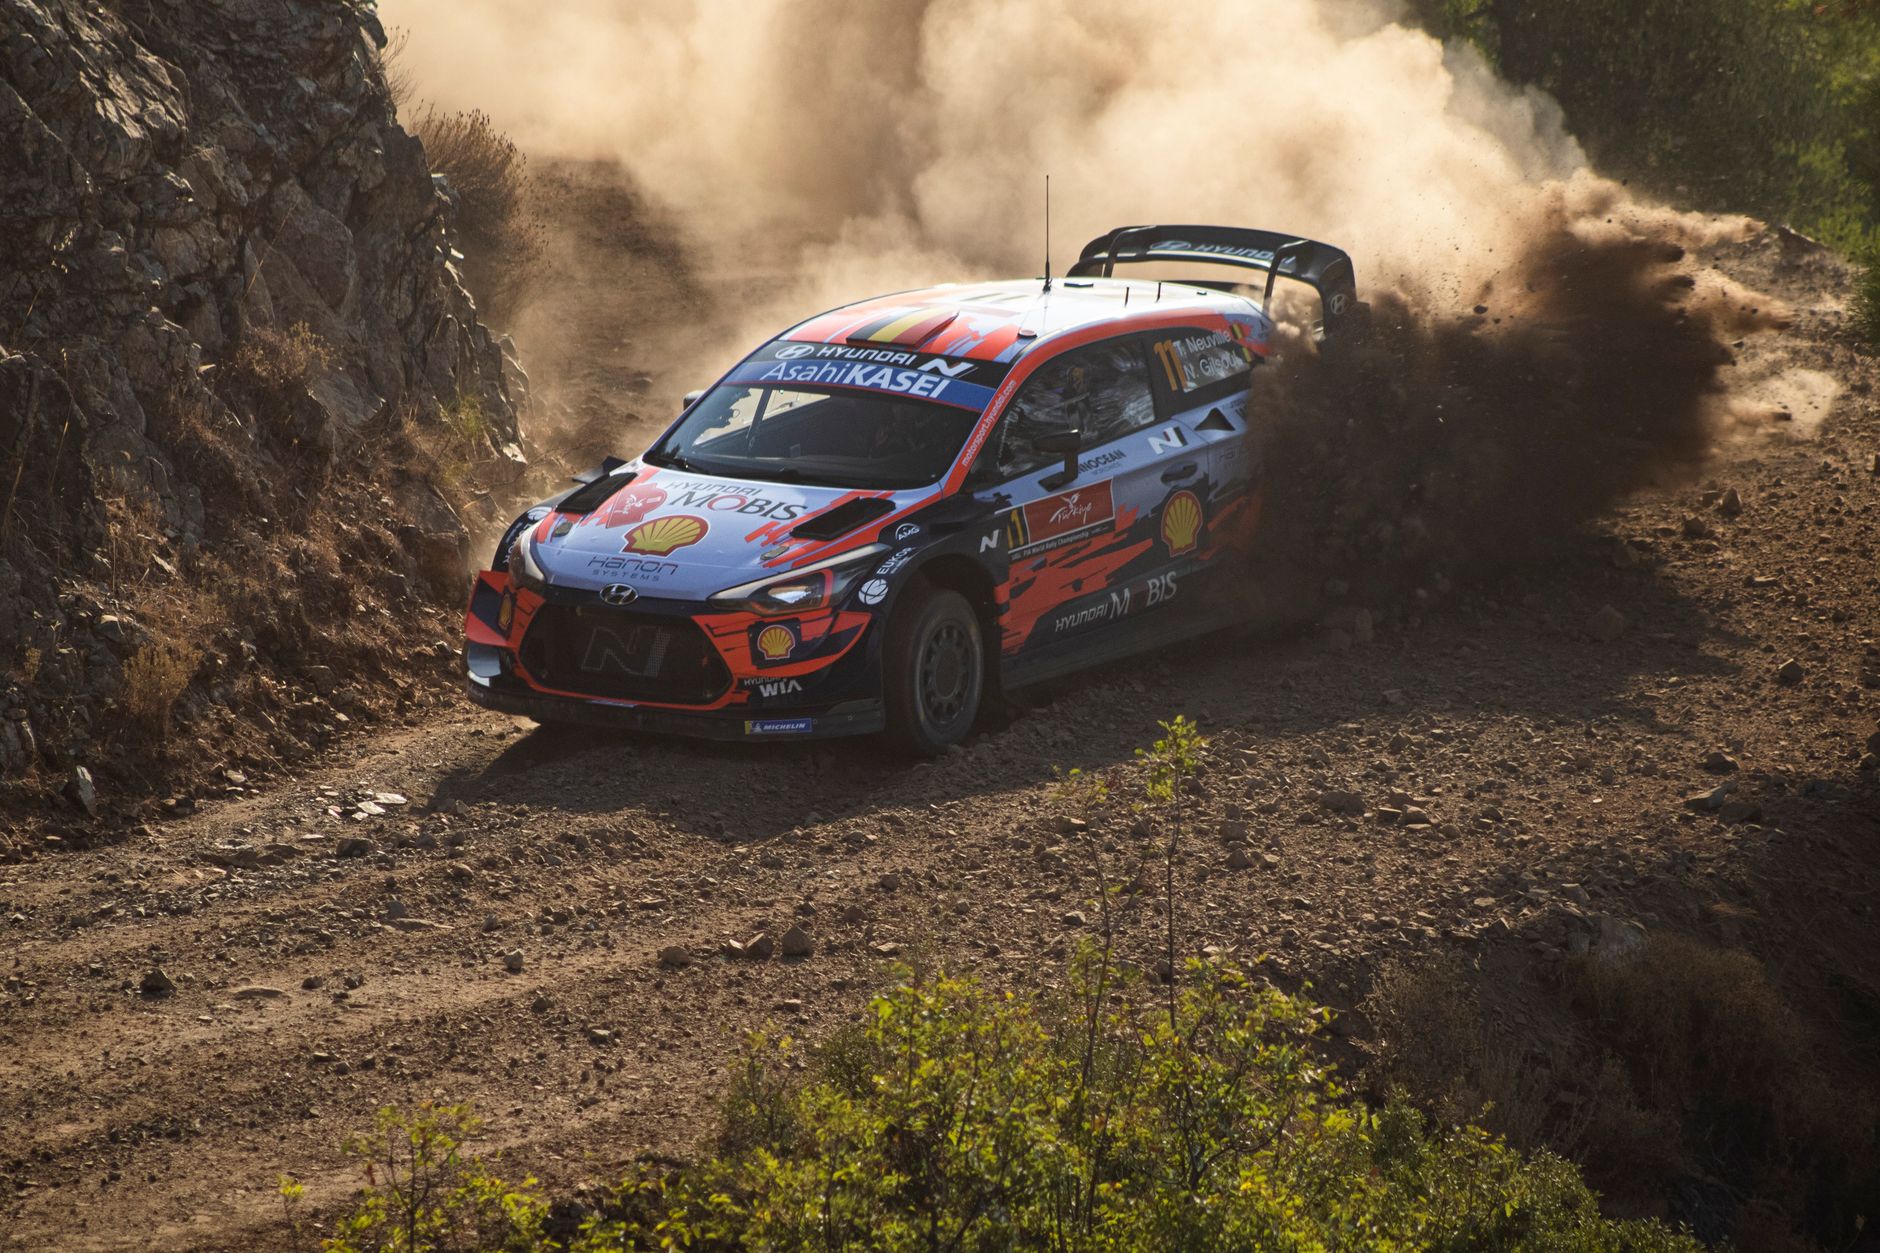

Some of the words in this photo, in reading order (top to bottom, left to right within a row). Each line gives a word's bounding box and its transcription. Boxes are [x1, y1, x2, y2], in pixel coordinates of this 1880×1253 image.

[1194, 244, 1296, 264] HYUNDI
[1185, 329, 1231, 354] Neuville
[817, 346, 916, 365] HYUNDAI
[1153, 339, 1188, 392] 11
[962, 380, 1018, 467] motorsport.hyundai.com
[668, 481, 763, 496] HYUNDAI
[669, 491, 808, 520] MOBIS
[593, 568, 660, 582] SYSTEMS
[1055, 603, 1109, 632] HYUNDAI
[763, 723, 806, 731] MICHELIN
